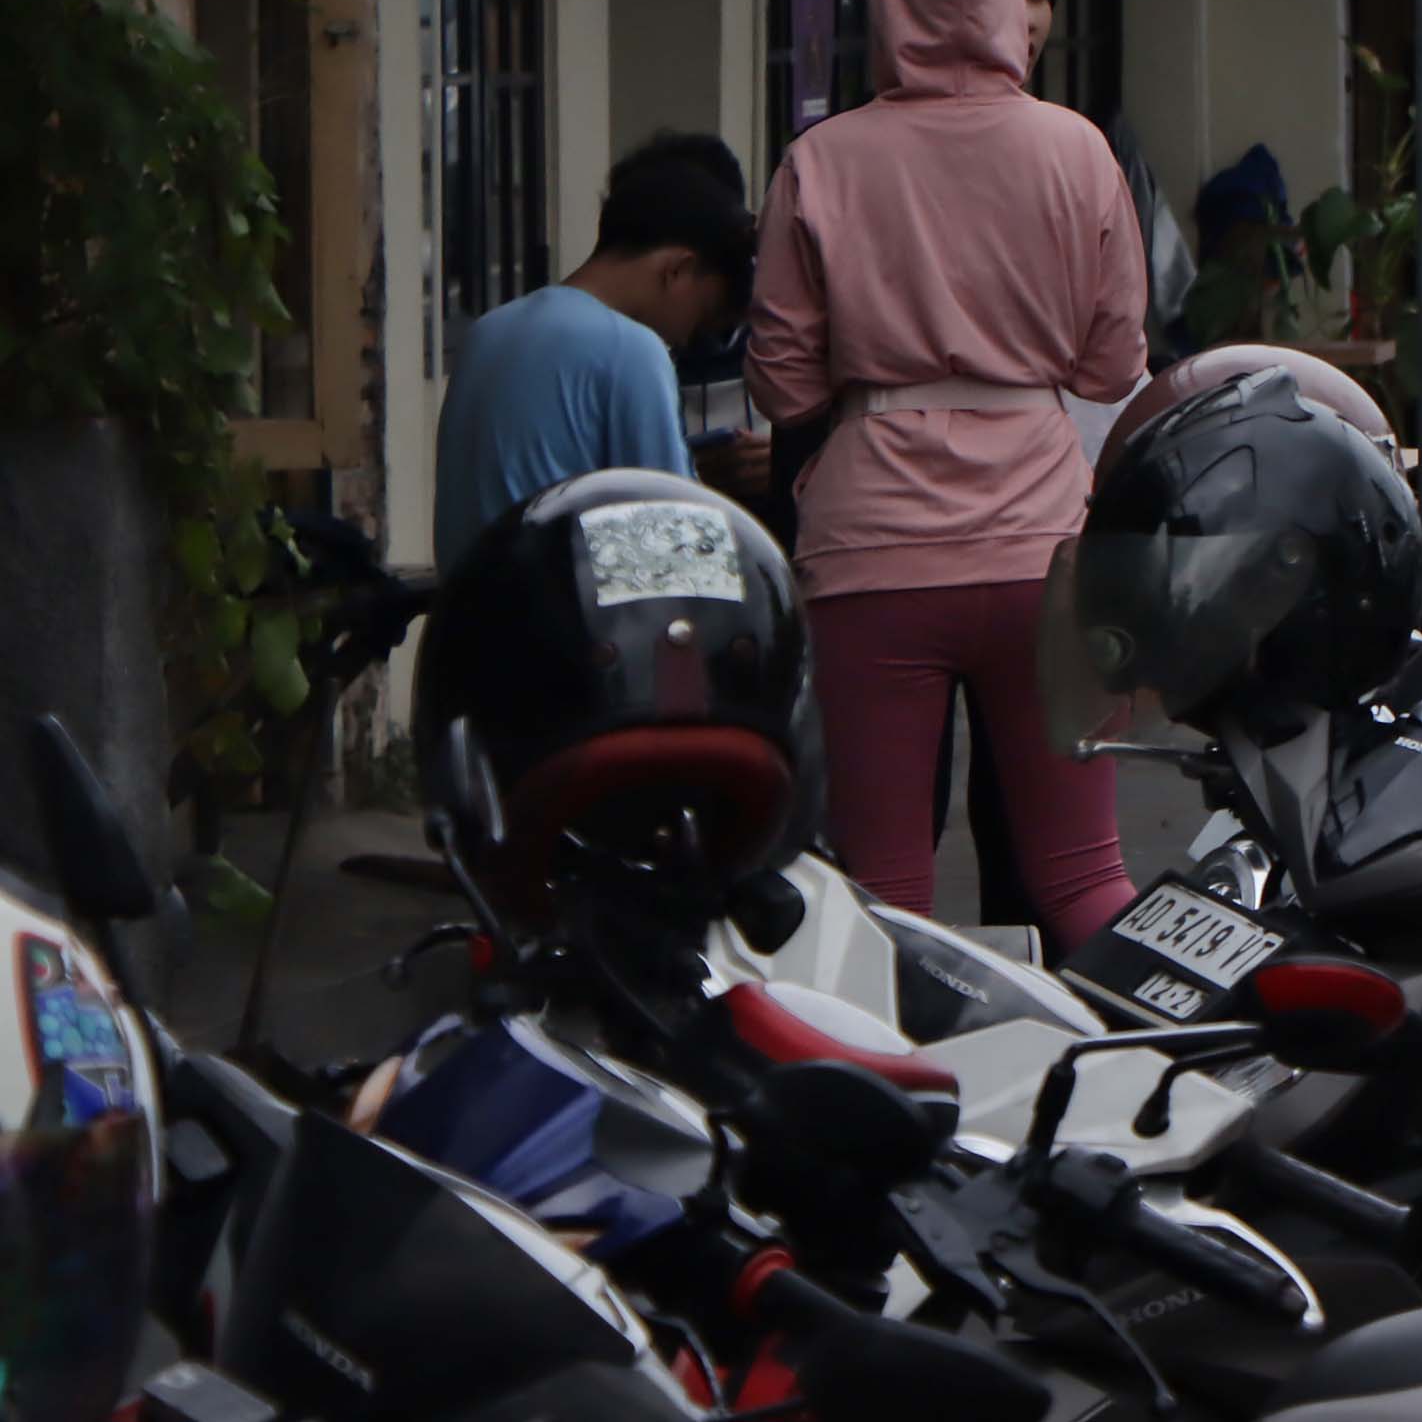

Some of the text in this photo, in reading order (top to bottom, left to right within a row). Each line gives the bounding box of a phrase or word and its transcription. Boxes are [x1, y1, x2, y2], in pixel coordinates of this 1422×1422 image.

[1123, 893, 1276, 977] AD 5419 VT
[918, 955, 990, 1005] HONDA
